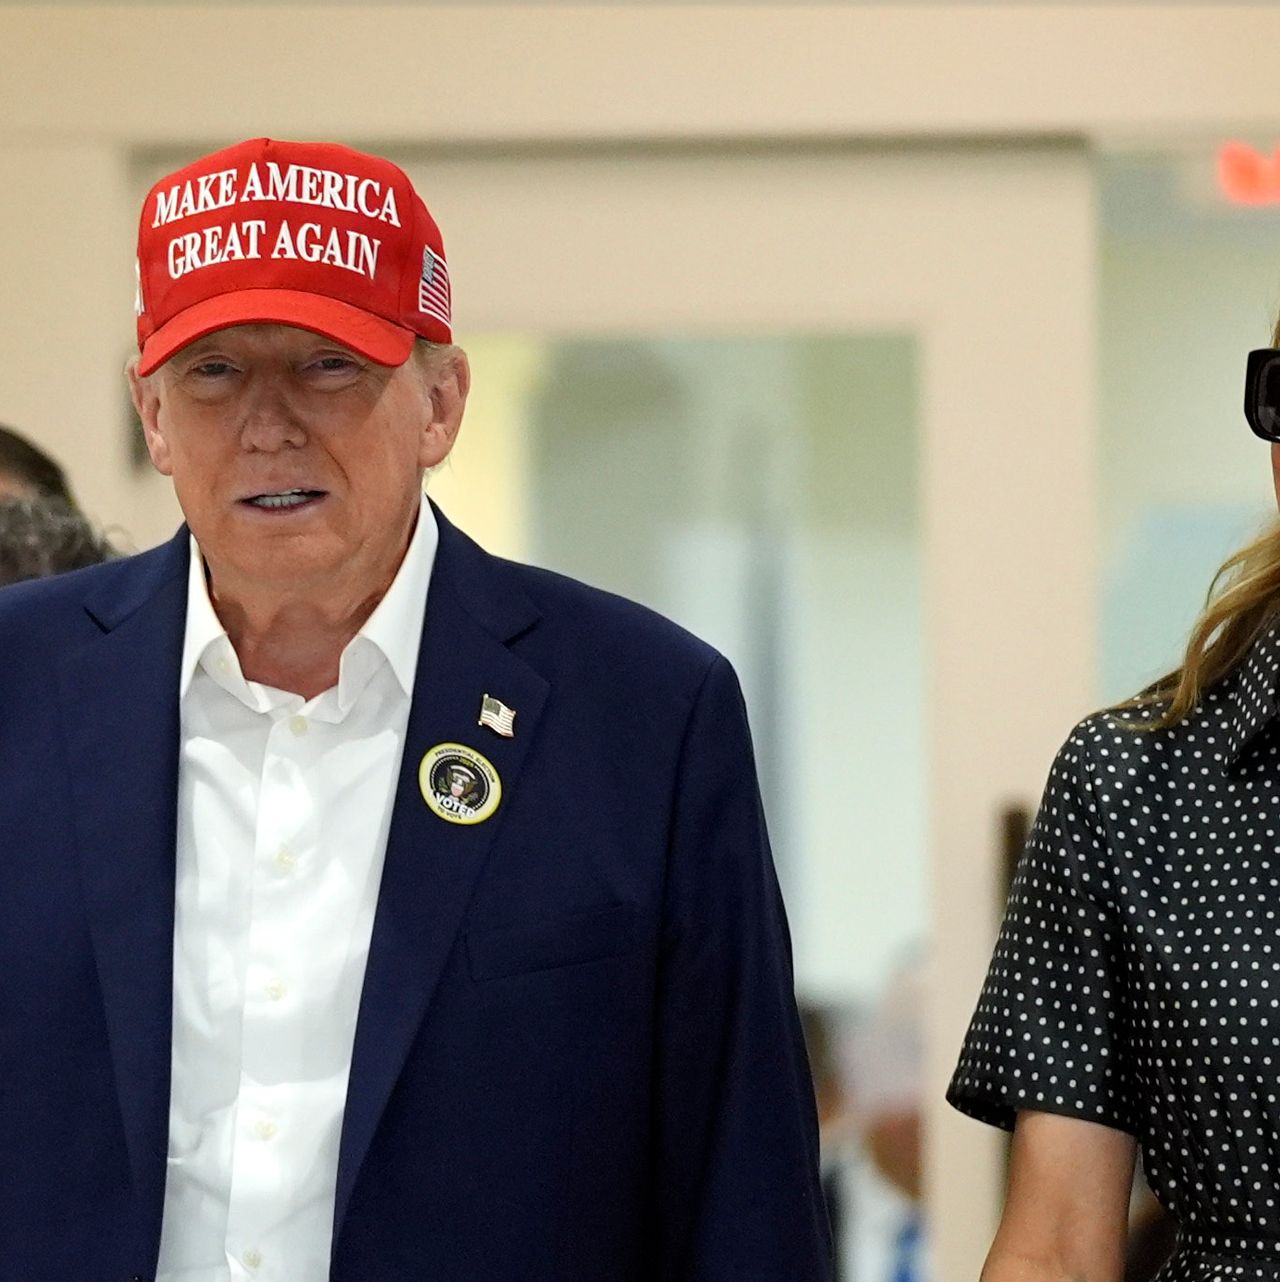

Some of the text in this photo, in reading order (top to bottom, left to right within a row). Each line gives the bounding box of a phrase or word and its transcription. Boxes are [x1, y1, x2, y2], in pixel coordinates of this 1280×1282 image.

[151, 162, 402, 229] MAKE AMERICA
[168, 219, 382, 280] GREAT AGAIN
[435, 792, 475, 818] VOTED
